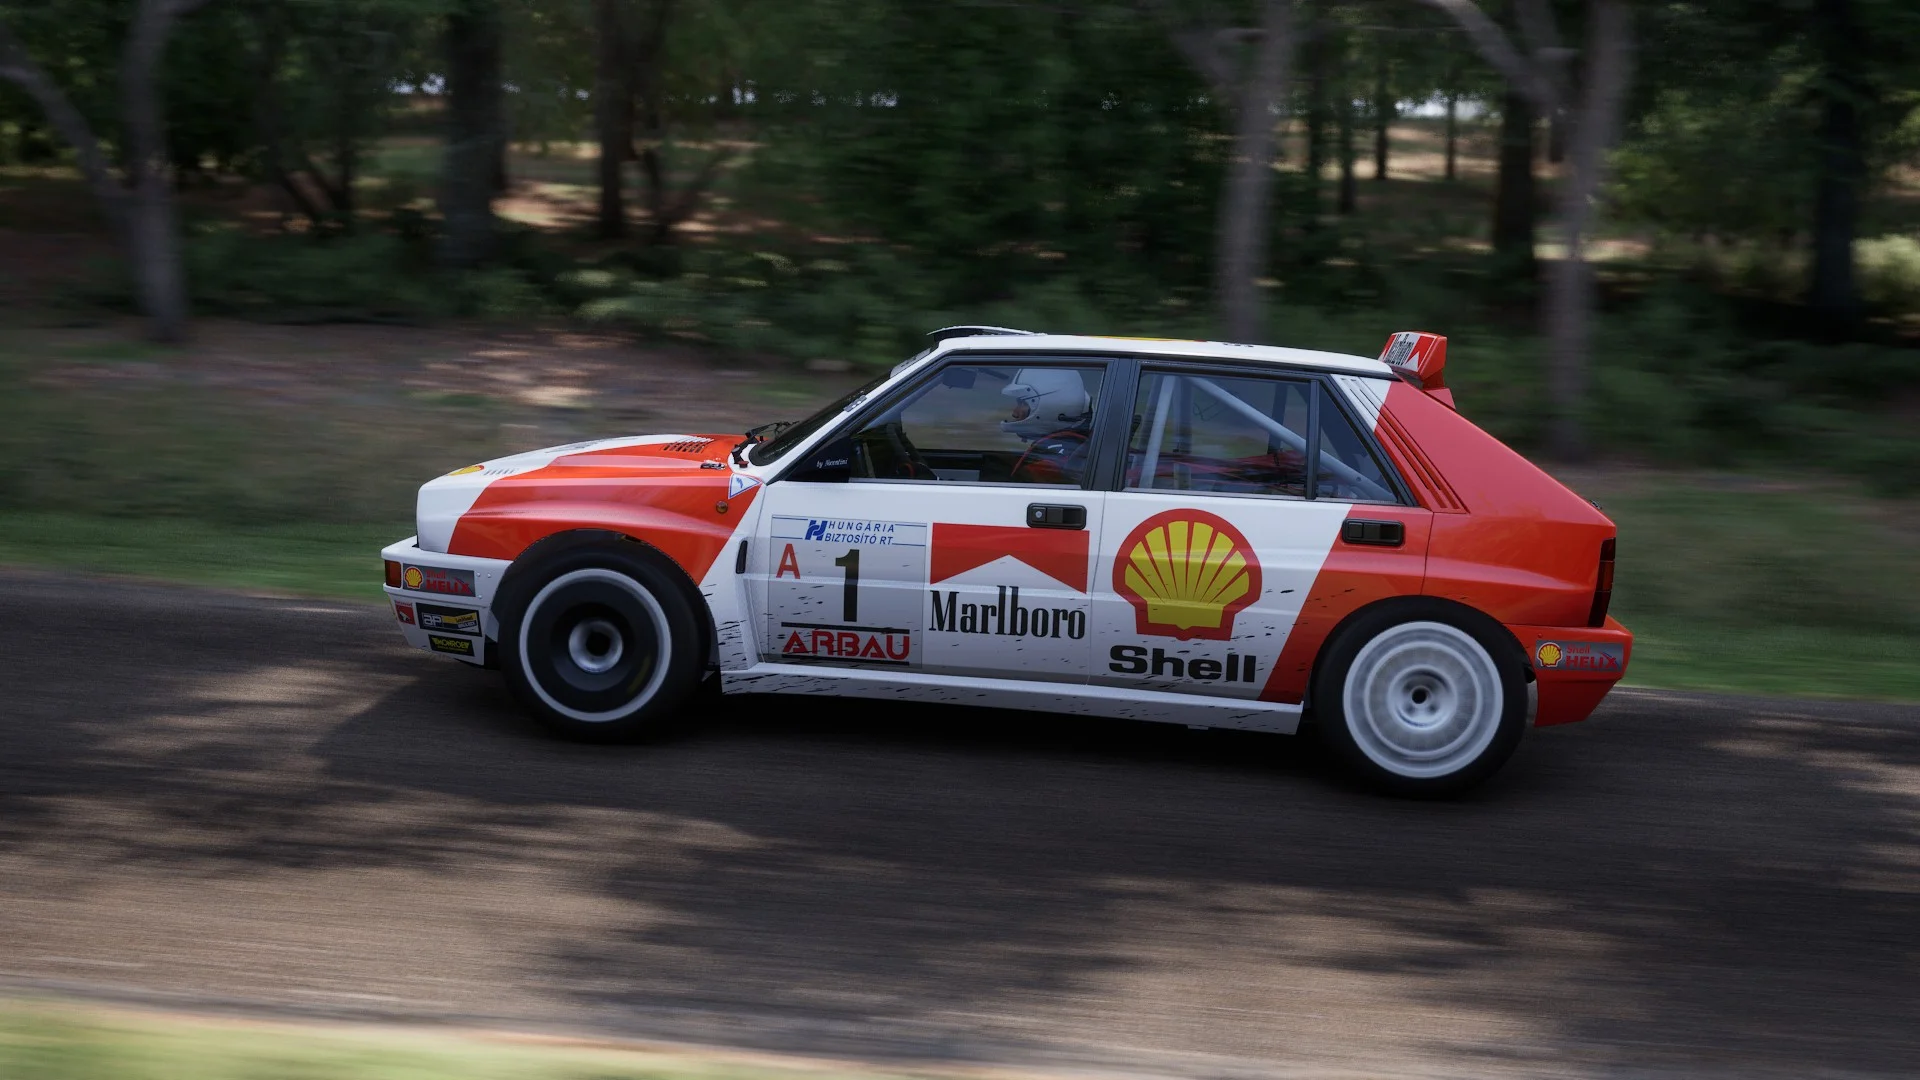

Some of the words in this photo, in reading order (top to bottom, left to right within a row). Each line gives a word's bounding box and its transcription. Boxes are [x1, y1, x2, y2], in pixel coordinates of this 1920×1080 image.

[828, 519, 895, 533] HUNGÁRIA
[824, 532, 877, 545] BIZTOSÍTÓ
[879, 535, 894, 546] RT
[775, 543, 801, 580] A
[426, 577, 473, 596] HELIX
[834, 548, 860, 623] 1
[929, 585, 1086, 641] Marlboro
[782, 629, 910, 661] ARBAU
[1566, 644, 1591, 655] Shell
[1108, 645, 1257, 684] Shell
[1566, 652, 1618, 670] HELIX
